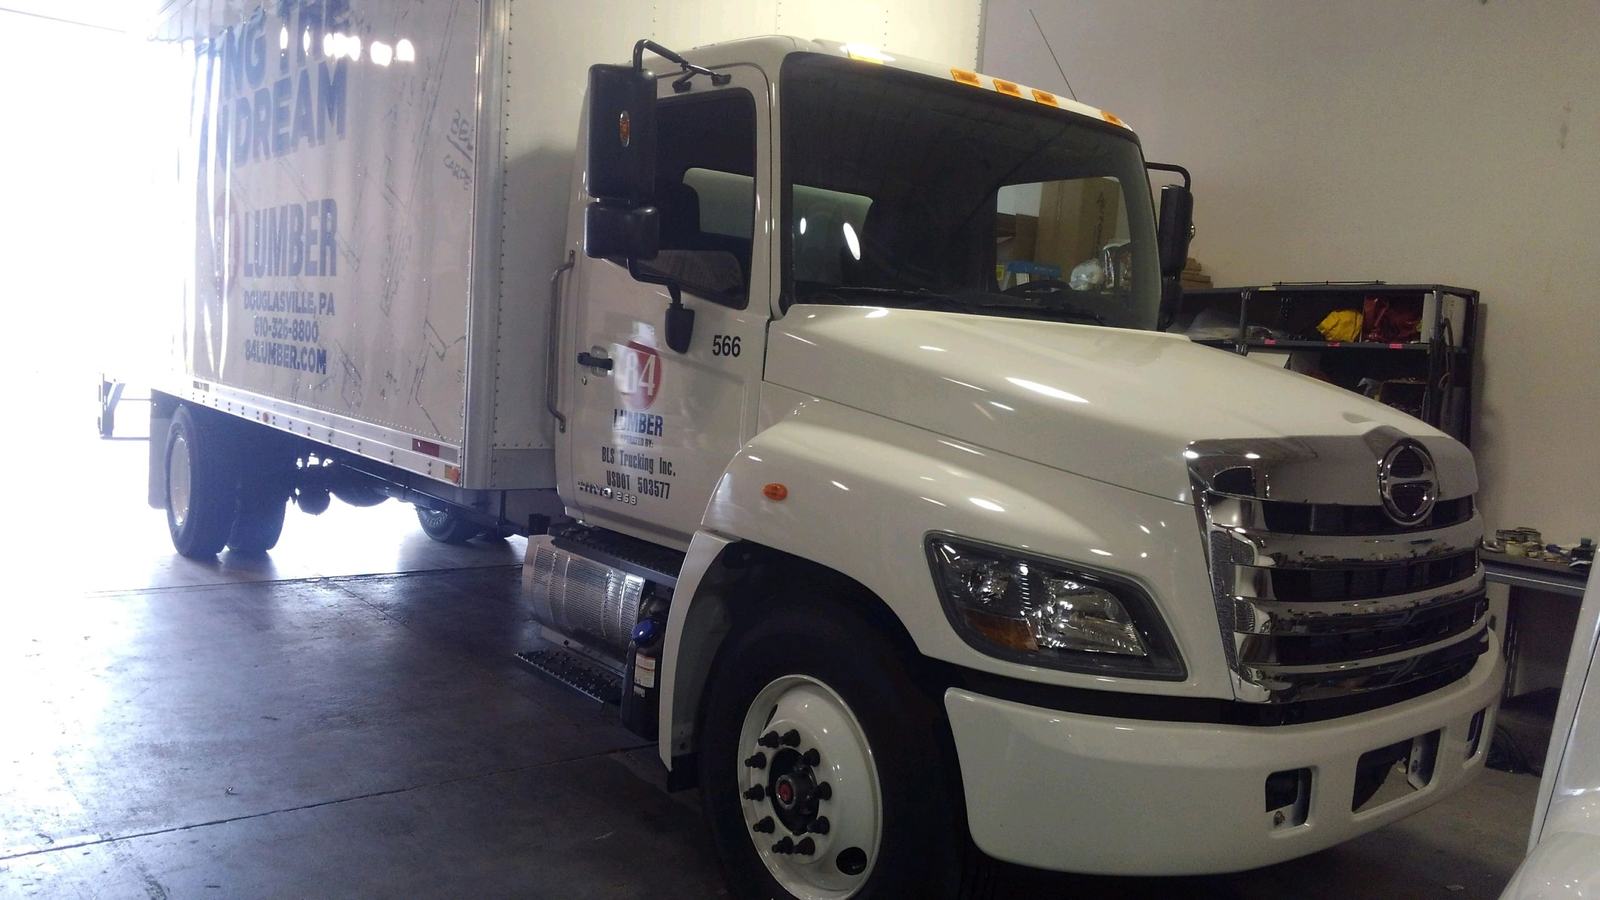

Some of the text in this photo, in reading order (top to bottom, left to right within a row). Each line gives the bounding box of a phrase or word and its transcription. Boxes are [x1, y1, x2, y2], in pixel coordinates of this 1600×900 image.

[234, 59, 348, 169] DREAM
[243, 198, 337, 278] LUMBER
[243, 289, 336, 318] DOUGLASVILLE, PA
[244, 339, 327, 375] 84LUMBER.COM
[712, 334, 741, 357] 566
[620, 451, 654, 476] Trucking
[659, 457, 676, 476] Inc.
[606, 470, 630, 490] USDOT
[637, 476, 670, 499] 503577
